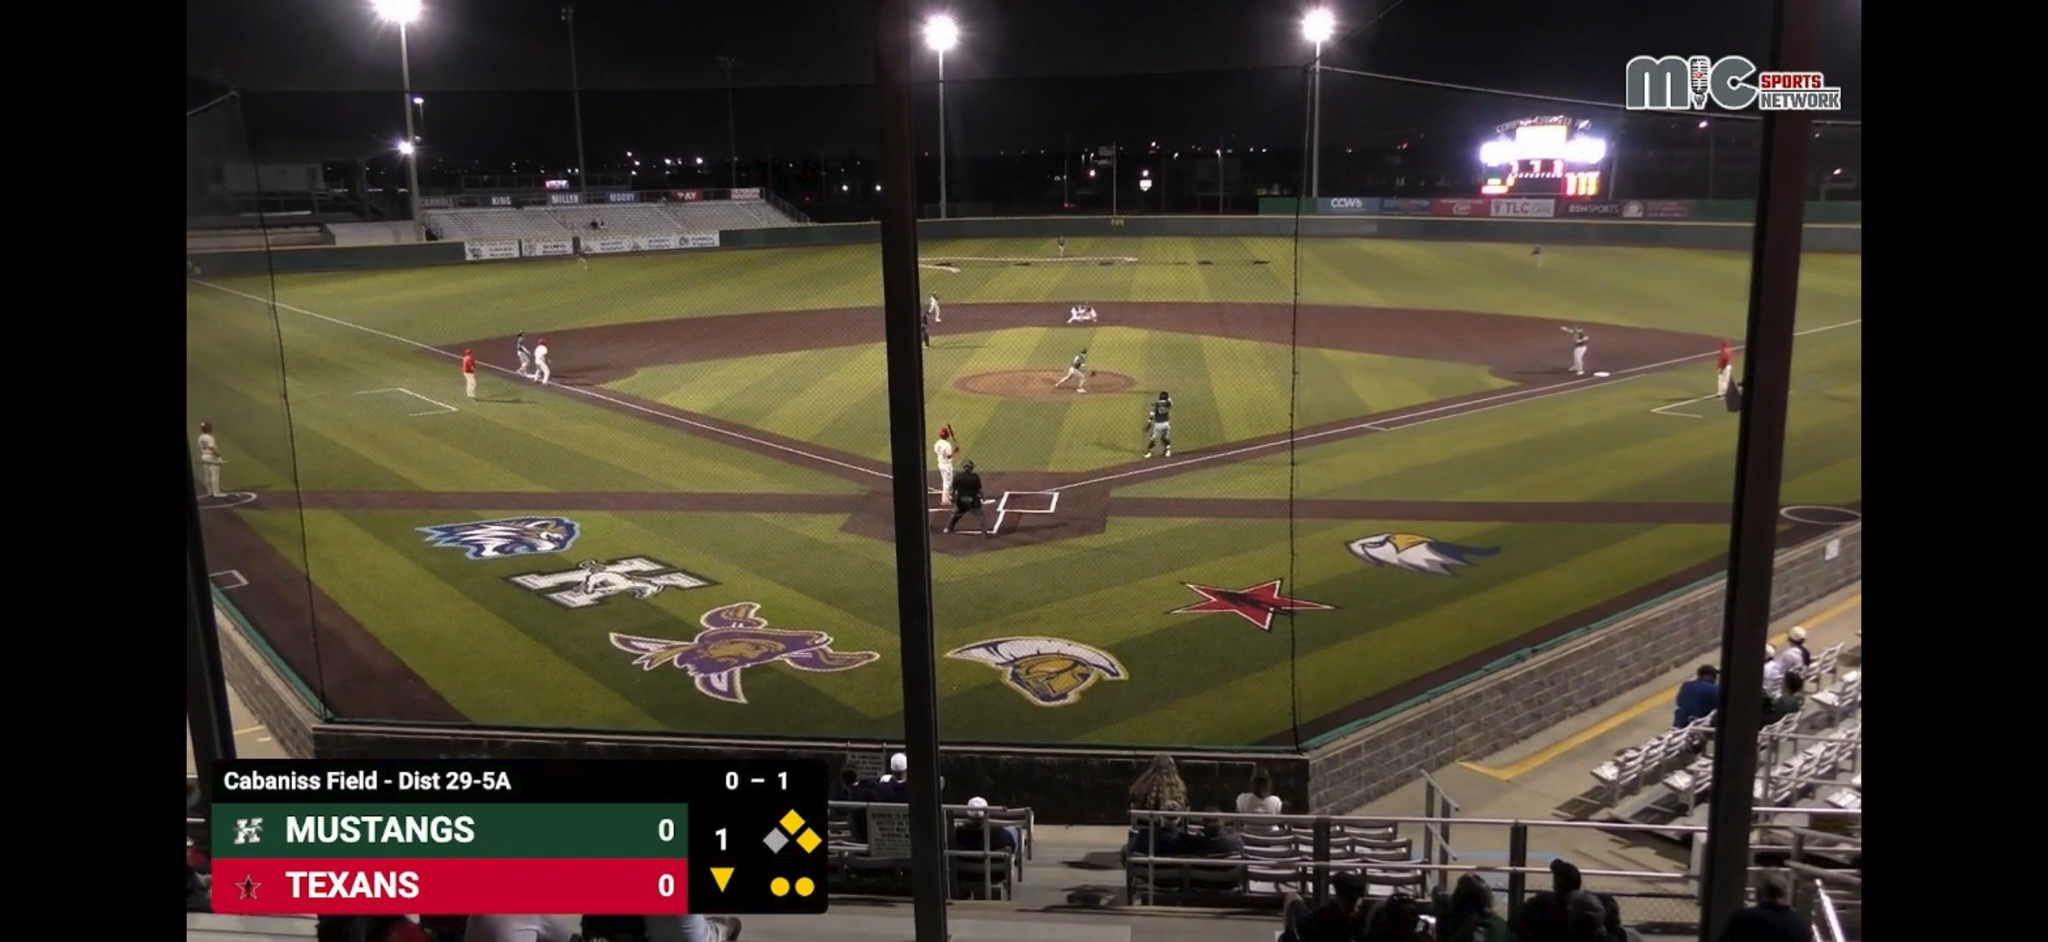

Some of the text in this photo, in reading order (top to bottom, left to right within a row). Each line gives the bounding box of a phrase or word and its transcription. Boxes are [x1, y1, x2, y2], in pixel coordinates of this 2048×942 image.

[491, 196, 512, 206] KING
[551, 194, 579, 204] MILLER
[1505, 201, 1530, 214] TLC
